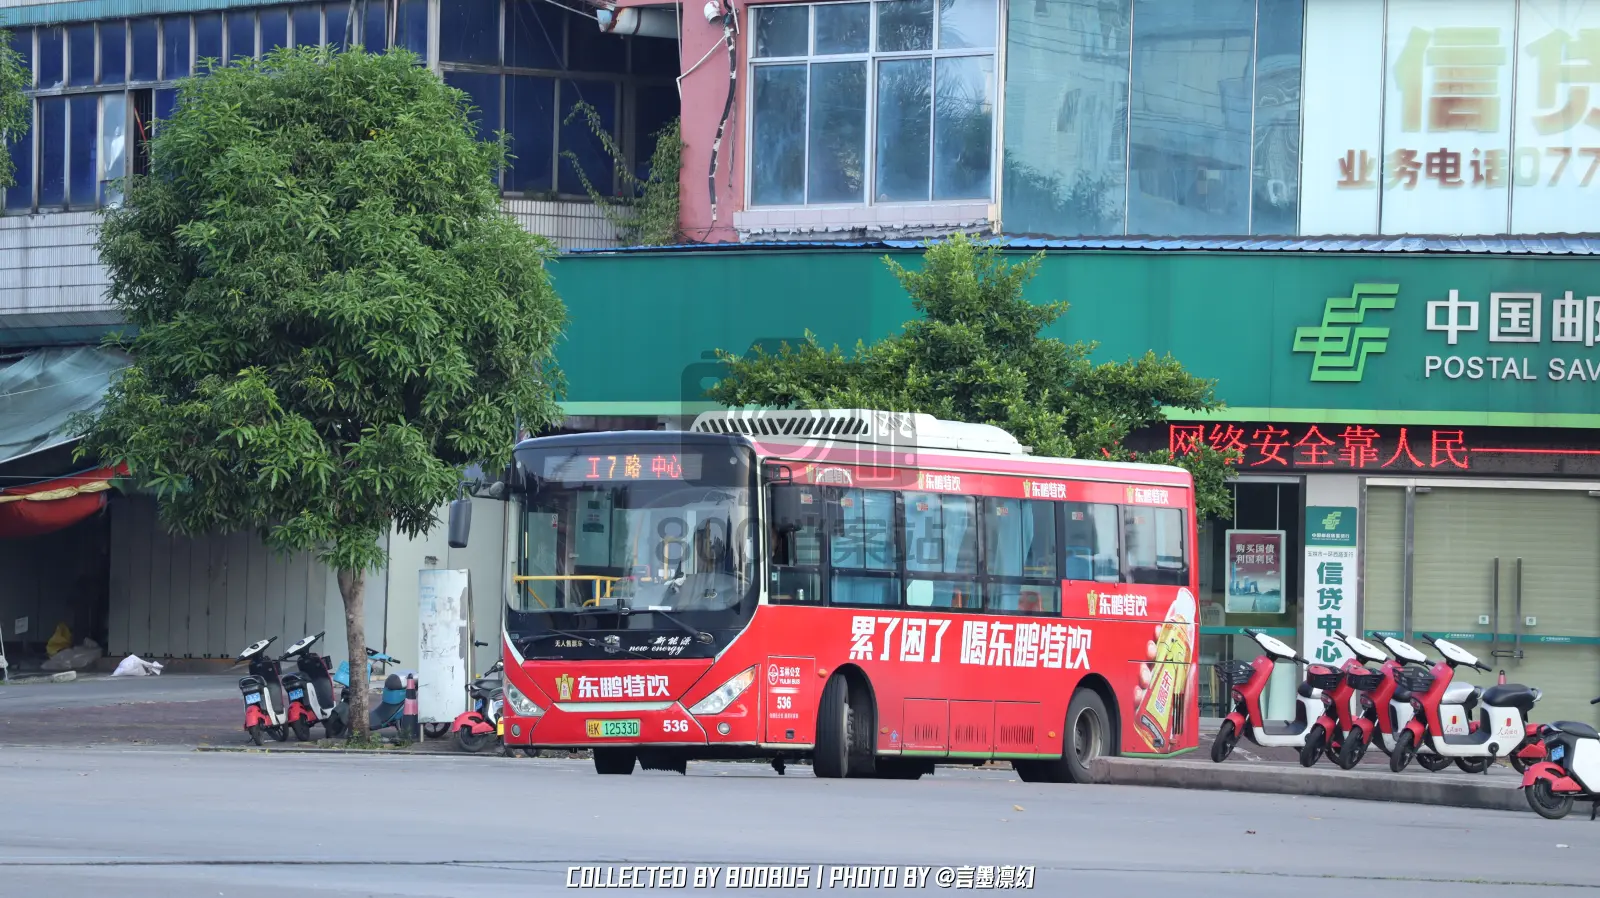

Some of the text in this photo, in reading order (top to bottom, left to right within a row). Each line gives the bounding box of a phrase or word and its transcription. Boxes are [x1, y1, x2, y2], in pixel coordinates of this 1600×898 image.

[1425, 356, 1537, 380] POSTAL
[925, 472, 961, 491] 东鹏特饮
[1032, 481, 1067, 499] 东鹏特饮
[1134, 487, 1169, 505] 东鹏特饮
[1099, 593, 1148, 617] 东鹏特饮
[1315, 561, 1343, 663] 信贷中心
[651, 645, 686, 656] energy
[848, 615, 1093, 670] 累了困了 喝东鹏特饮
[577, 674, 671, 698] 东鹏特饮
[777, 696, 792, 710] 536
[662, 719, 689, 733] 536
